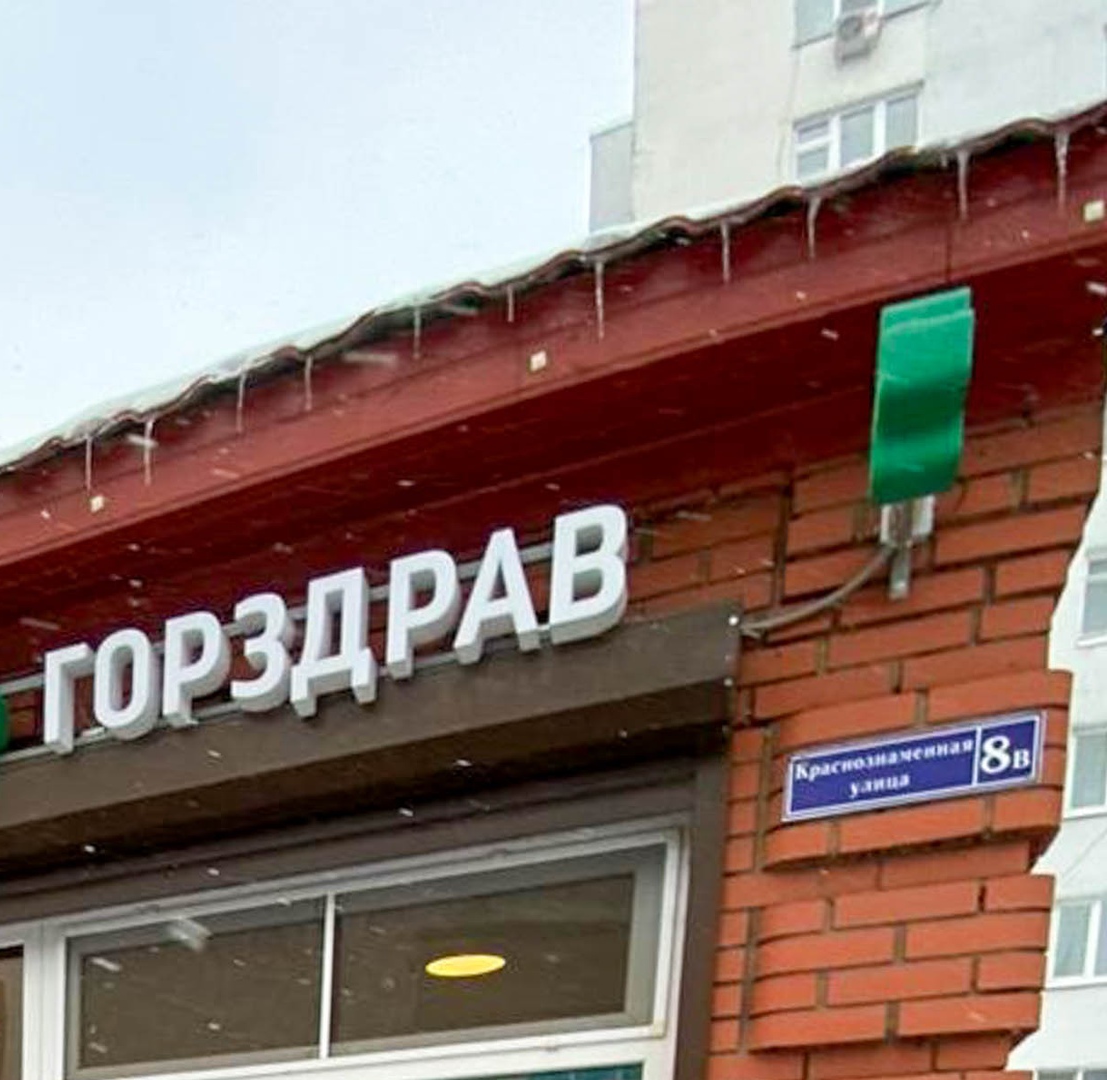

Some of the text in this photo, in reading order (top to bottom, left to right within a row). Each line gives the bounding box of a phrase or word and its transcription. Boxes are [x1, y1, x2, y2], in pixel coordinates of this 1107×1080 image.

[44, 504, 629, 754] ГОРЗДРАВ
[794, 738, 974, 781] Краснознаменная
[848, 773, 910, 798] улица
